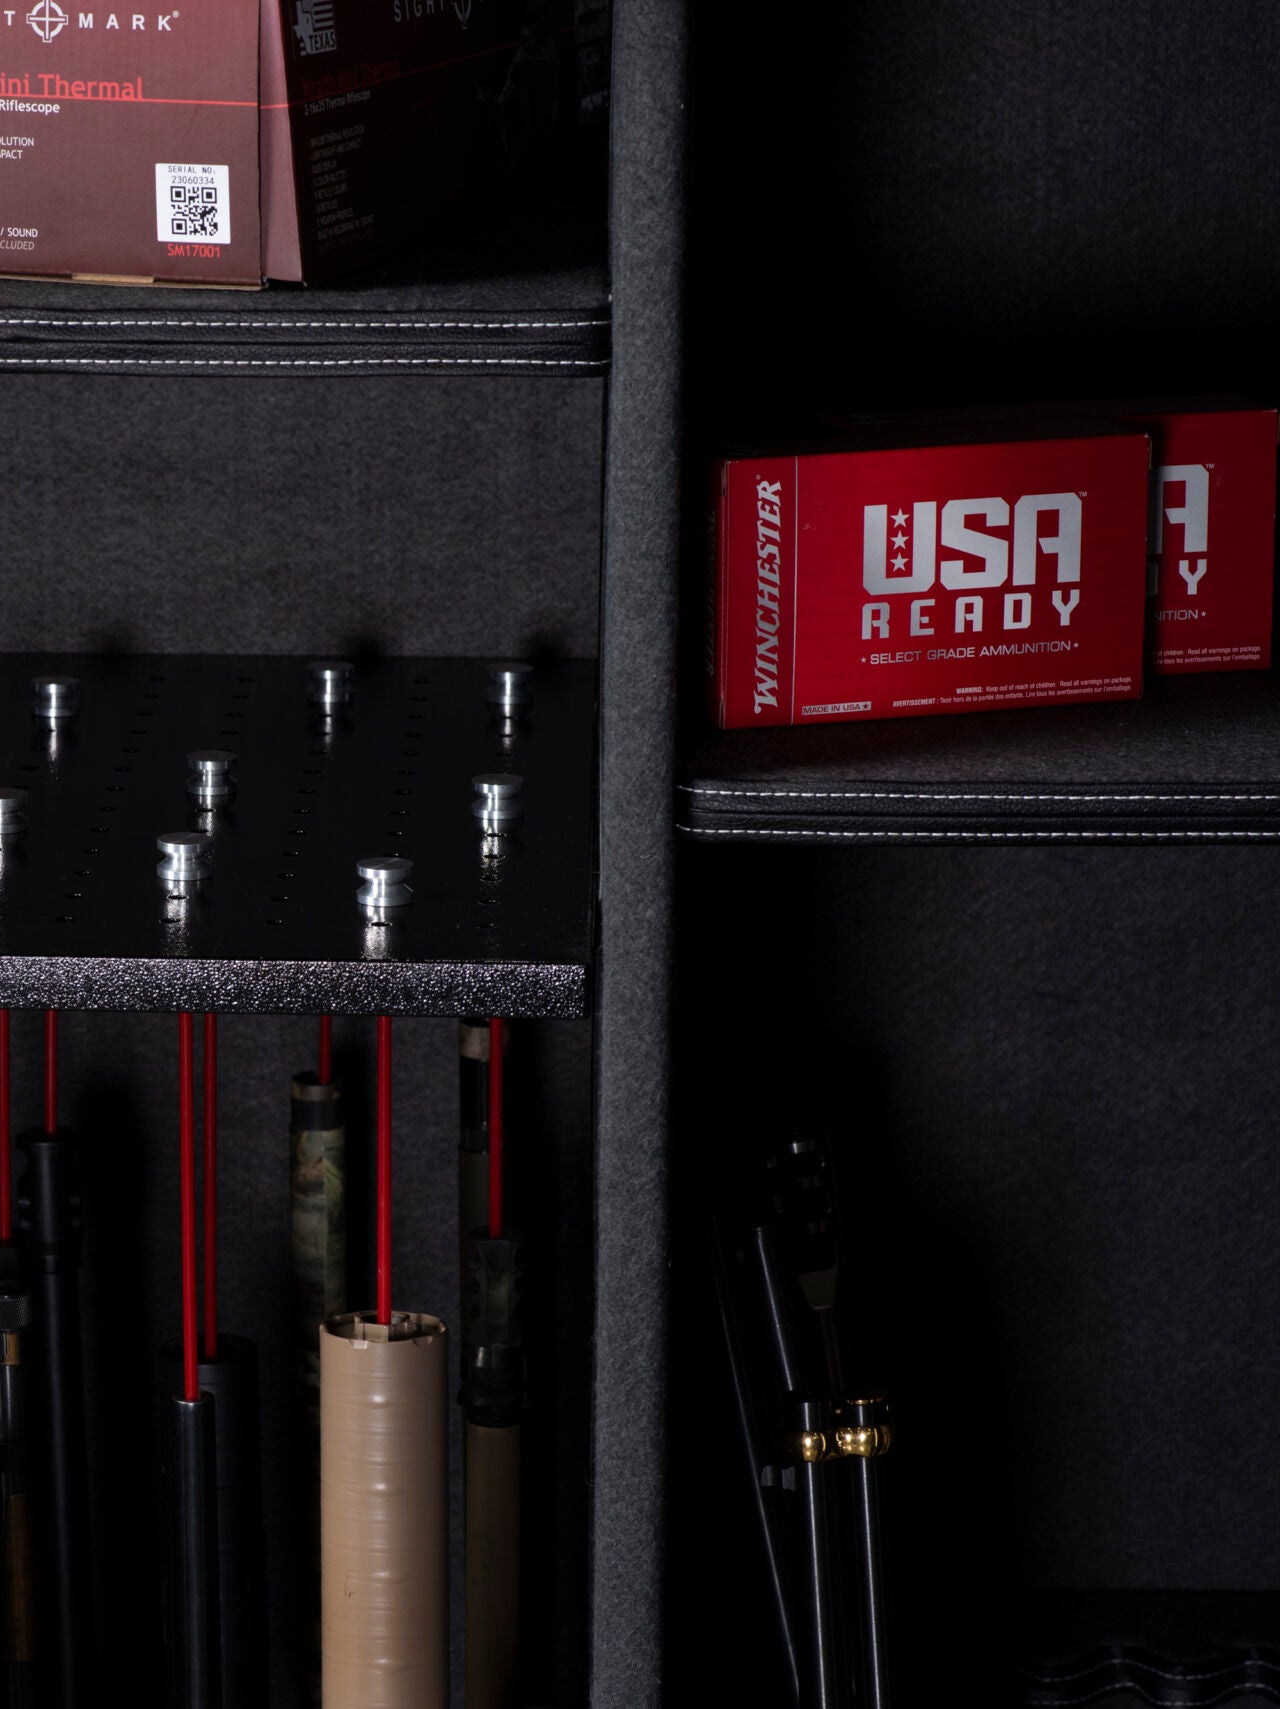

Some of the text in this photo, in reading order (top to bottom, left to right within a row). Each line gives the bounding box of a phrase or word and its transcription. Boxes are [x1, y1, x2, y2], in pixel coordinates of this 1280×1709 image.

[308, 31, 335, 51] TEXAS
[38, 74, 144, 100] Thermal
[167, 165, 197, 174] SERIAL
[171, 176, 215, 184] 23060334
[7, 227, 38, 238] SOUND
[167, 243, 221, 258] SM17001
[862, 492, 1082, 596] USA
[753, 479, 782, 714] WINCHESTER
[861, 589, 1080, 640] READY
[870, 640, 1071, 664] SELECT GRADE AMMUNITION
[803, 705, 828, 714] MADE
[843, 703, 860, 711] USA
